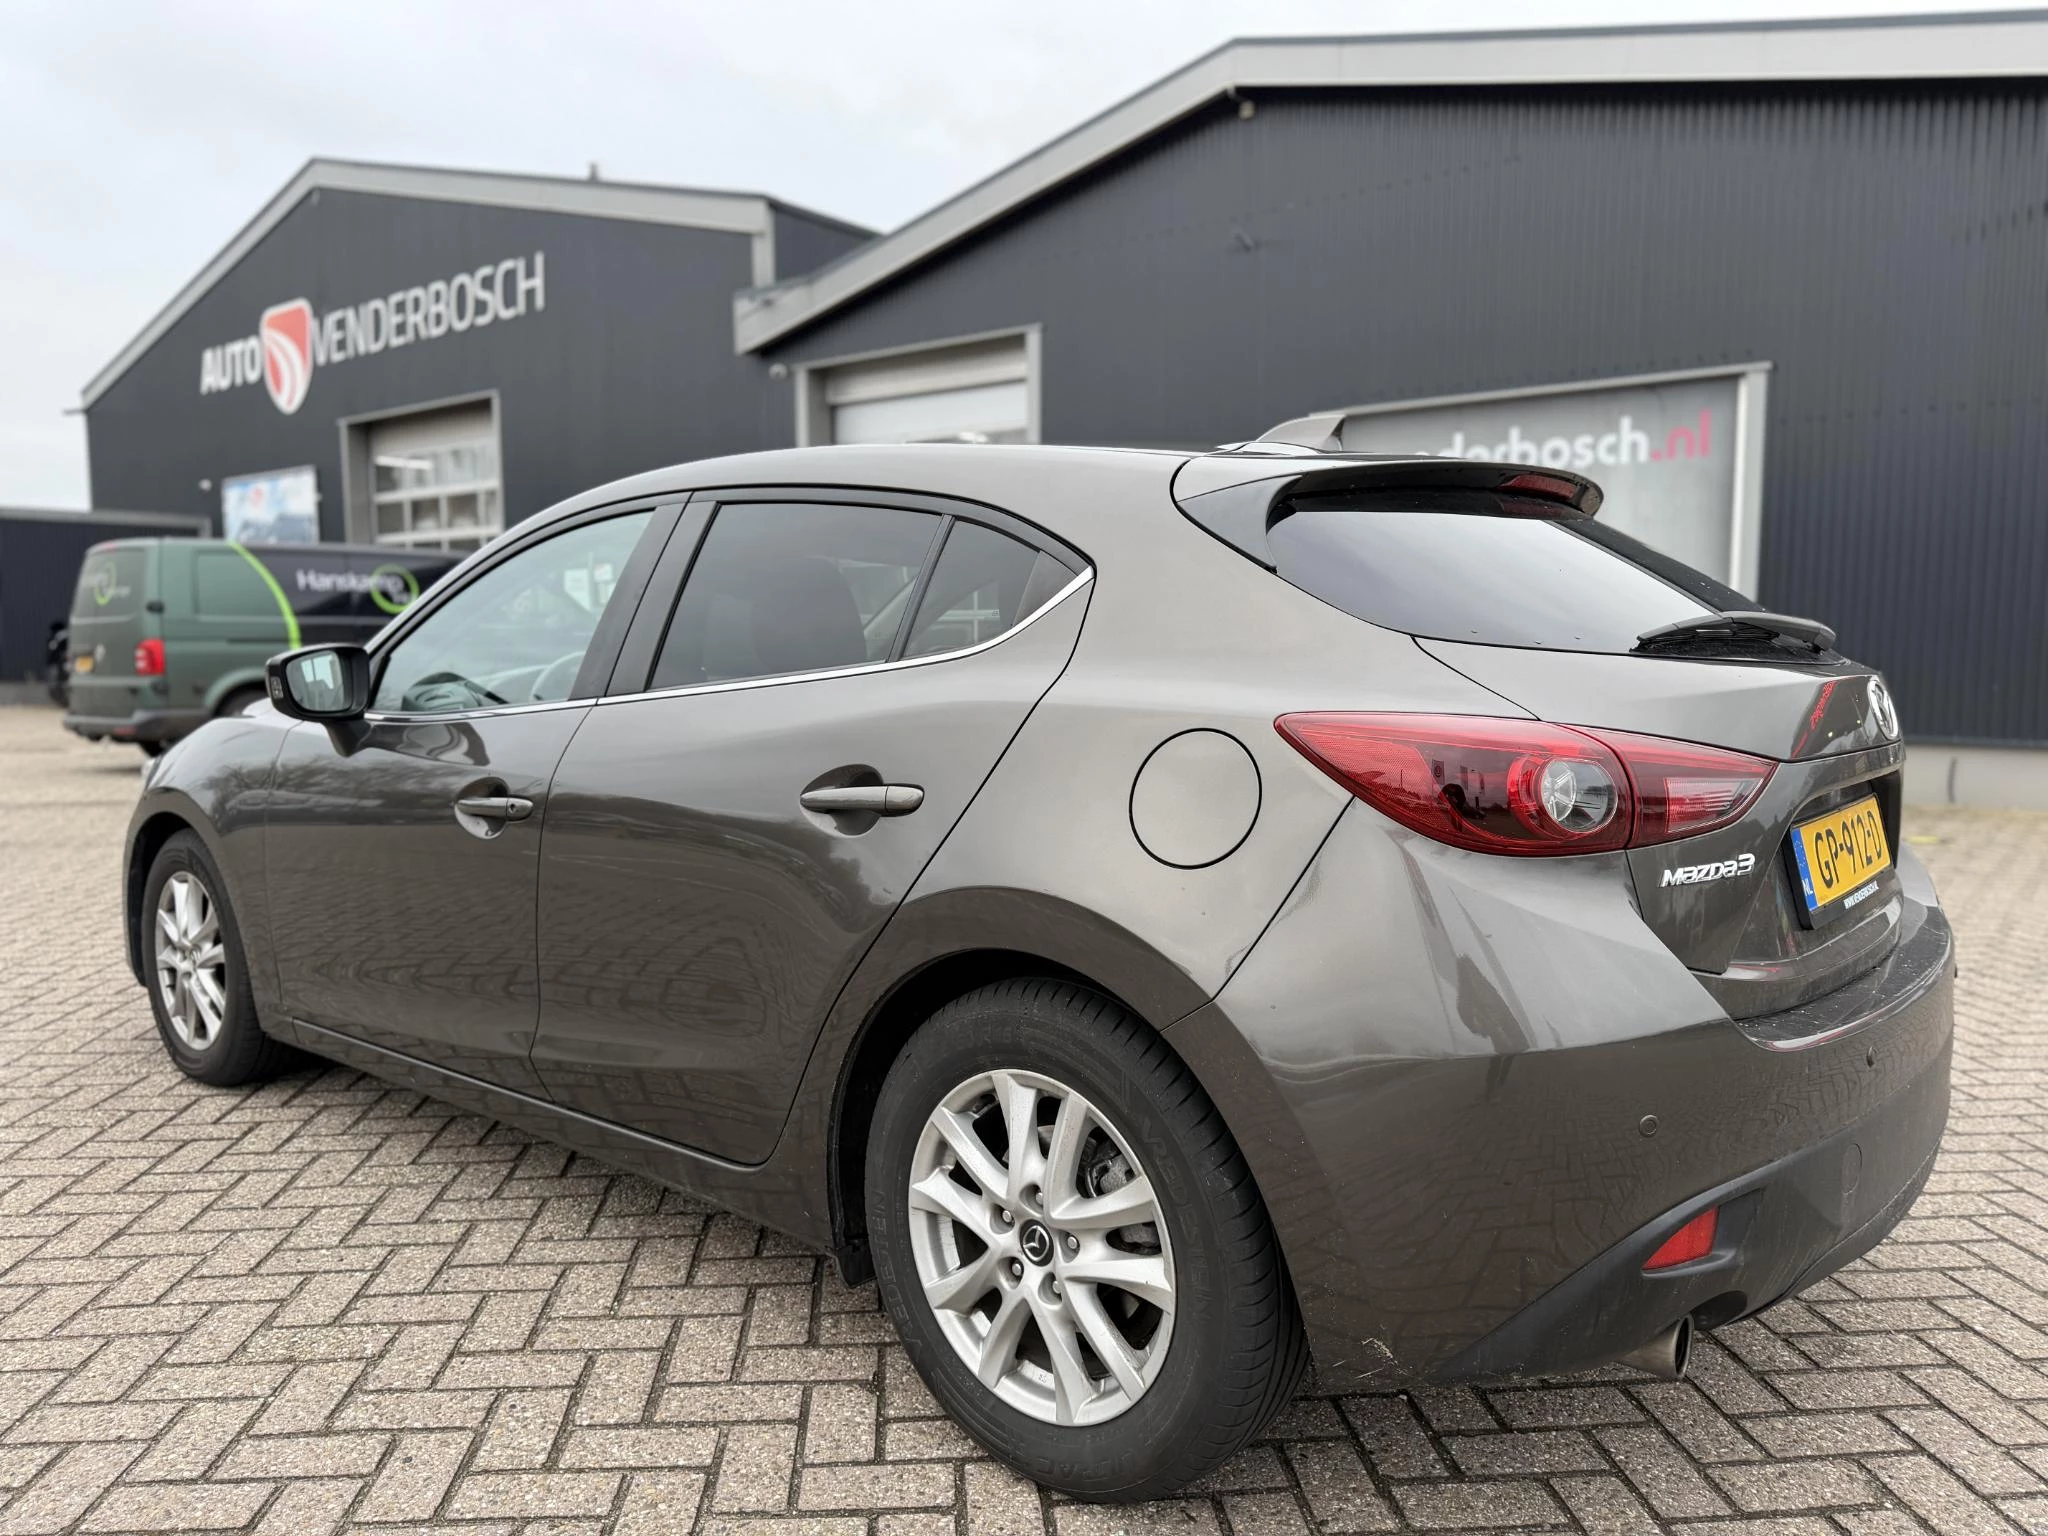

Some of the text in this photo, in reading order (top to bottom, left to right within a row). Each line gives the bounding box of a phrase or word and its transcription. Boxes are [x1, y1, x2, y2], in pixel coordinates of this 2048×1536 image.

[200, 250, 545, 395] AUTO VENDERBOSCH
[1414, 408, 1712, 469] derbosch.nl
[1814, 810, 1882, 890] GP-912-D
[1802, 879, 1814, 897] NL
